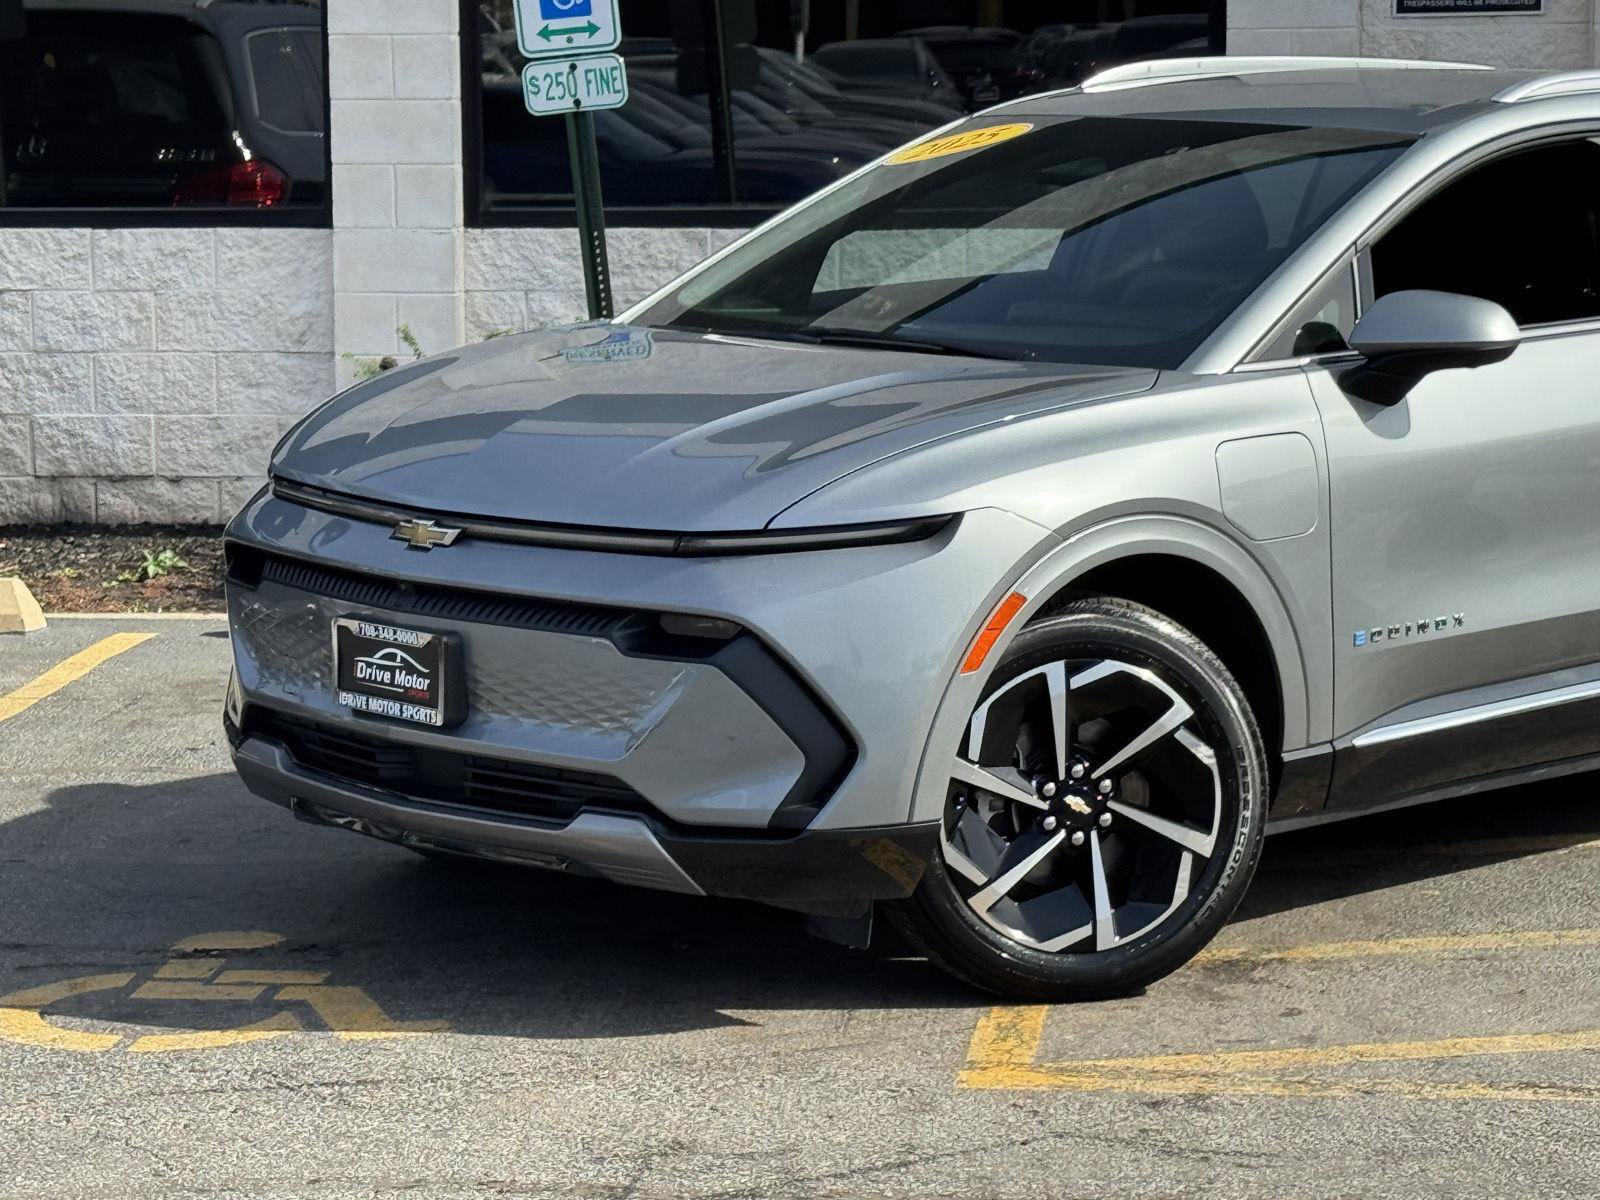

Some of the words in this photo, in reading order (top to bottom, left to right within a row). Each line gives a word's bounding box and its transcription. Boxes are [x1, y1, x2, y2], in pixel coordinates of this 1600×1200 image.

[528, 70, 578, 101] $250
[584, 66, 622, 98] FINE
[358, 623, 419, 646] 708-348-0000
[394, 669, 431, 692] Motor
[368, 696, 401, 716] MOTOR
[402, 705, 438, 723] SPORTS
